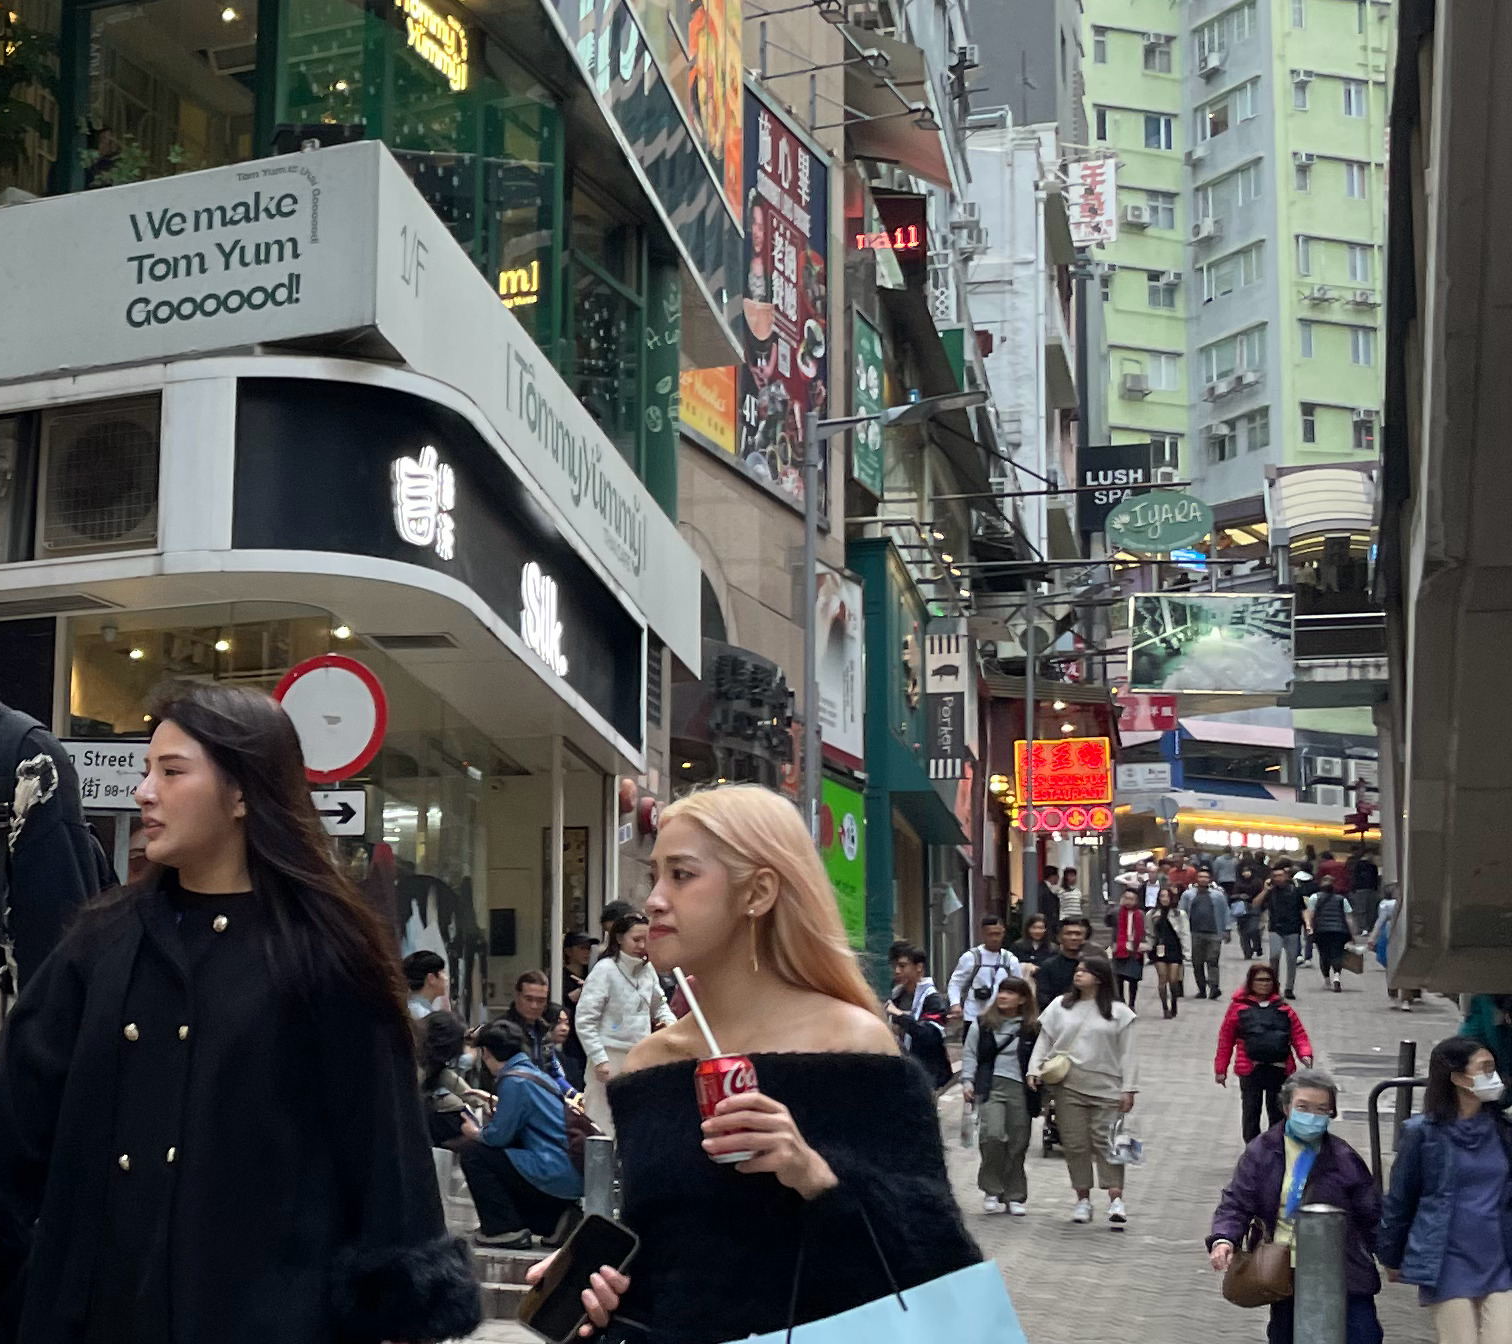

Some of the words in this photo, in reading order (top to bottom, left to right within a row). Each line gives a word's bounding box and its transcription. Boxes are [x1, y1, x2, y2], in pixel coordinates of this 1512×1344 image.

[129, 207, 187, 242] We
[193, 191, 299, 233] make
[127, 250, 209, 284] Tom
[215, 236, 303, 272] Yum
[400, 225, 429, 298] 1/F
[126, 272, 302, 329] Goooood!
[1085, 468, 1143, 486] LUSH
[1094, 489, 1134, 505] SPA
[83, 750, 134, 769] Street
[82, 778, 102, 800] 街
[104, 785, 138, 798] 98-14
